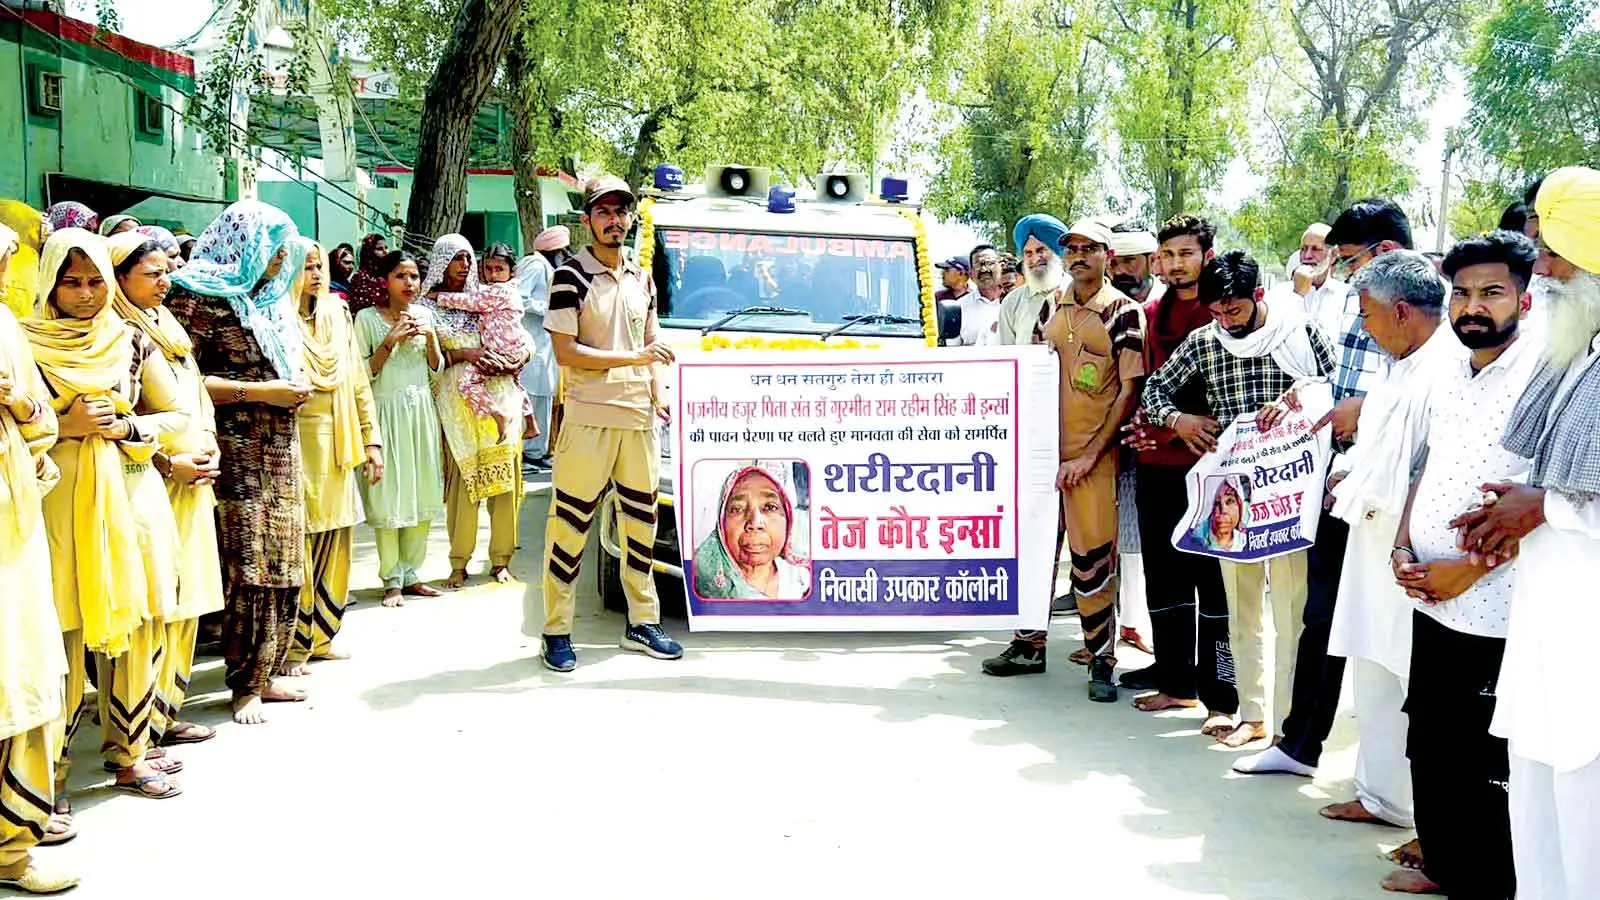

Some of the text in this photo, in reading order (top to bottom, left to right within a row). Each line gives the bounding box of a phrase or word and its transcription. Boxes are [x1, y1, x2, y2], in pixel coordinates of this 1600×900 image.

[751, 368, 944, 390] धन धन सतगुरु तेरा ही आसरा
[762, 395, 787, 418] पिता
[791, 395, 810, 418] संत
[815, 396, 827, 418] डॉ
[831, 394, 871, 423] गुरमीत
[875, 399, 896, 417] राम
[901, 393, 930, 417] रहीम
[934, 393, 957, 417] सिंह
[961, 392, 977, 416] जी
[980, 392, 1009, 420] इन्सां
[689, 428, 705, 443] की
[709, 431, 738, 443] पावन
[743, 428, 774, 443] प्रेरणा
[778, 431, 793, 443] पर
[830, 430, 846, 446] हुए
[850, 429, 894, 442] मानवता
[898, 426, 913, 441] की
[918, 426, 940, 441] सेवा
[944, 425, 960, 441] को
[964, 425, 1008, 441] समर्पित
[824, 451, 998, 495] शरीरदानी
[1252, 450, 1314, 490] रीरदानी
[820, 505, 1004, 555] तेज कौर इन्सां
[819, 566, 1009, 603] निवासी उपकार कॉलोनी
[1216, 640, 1237, 684] NIKE
